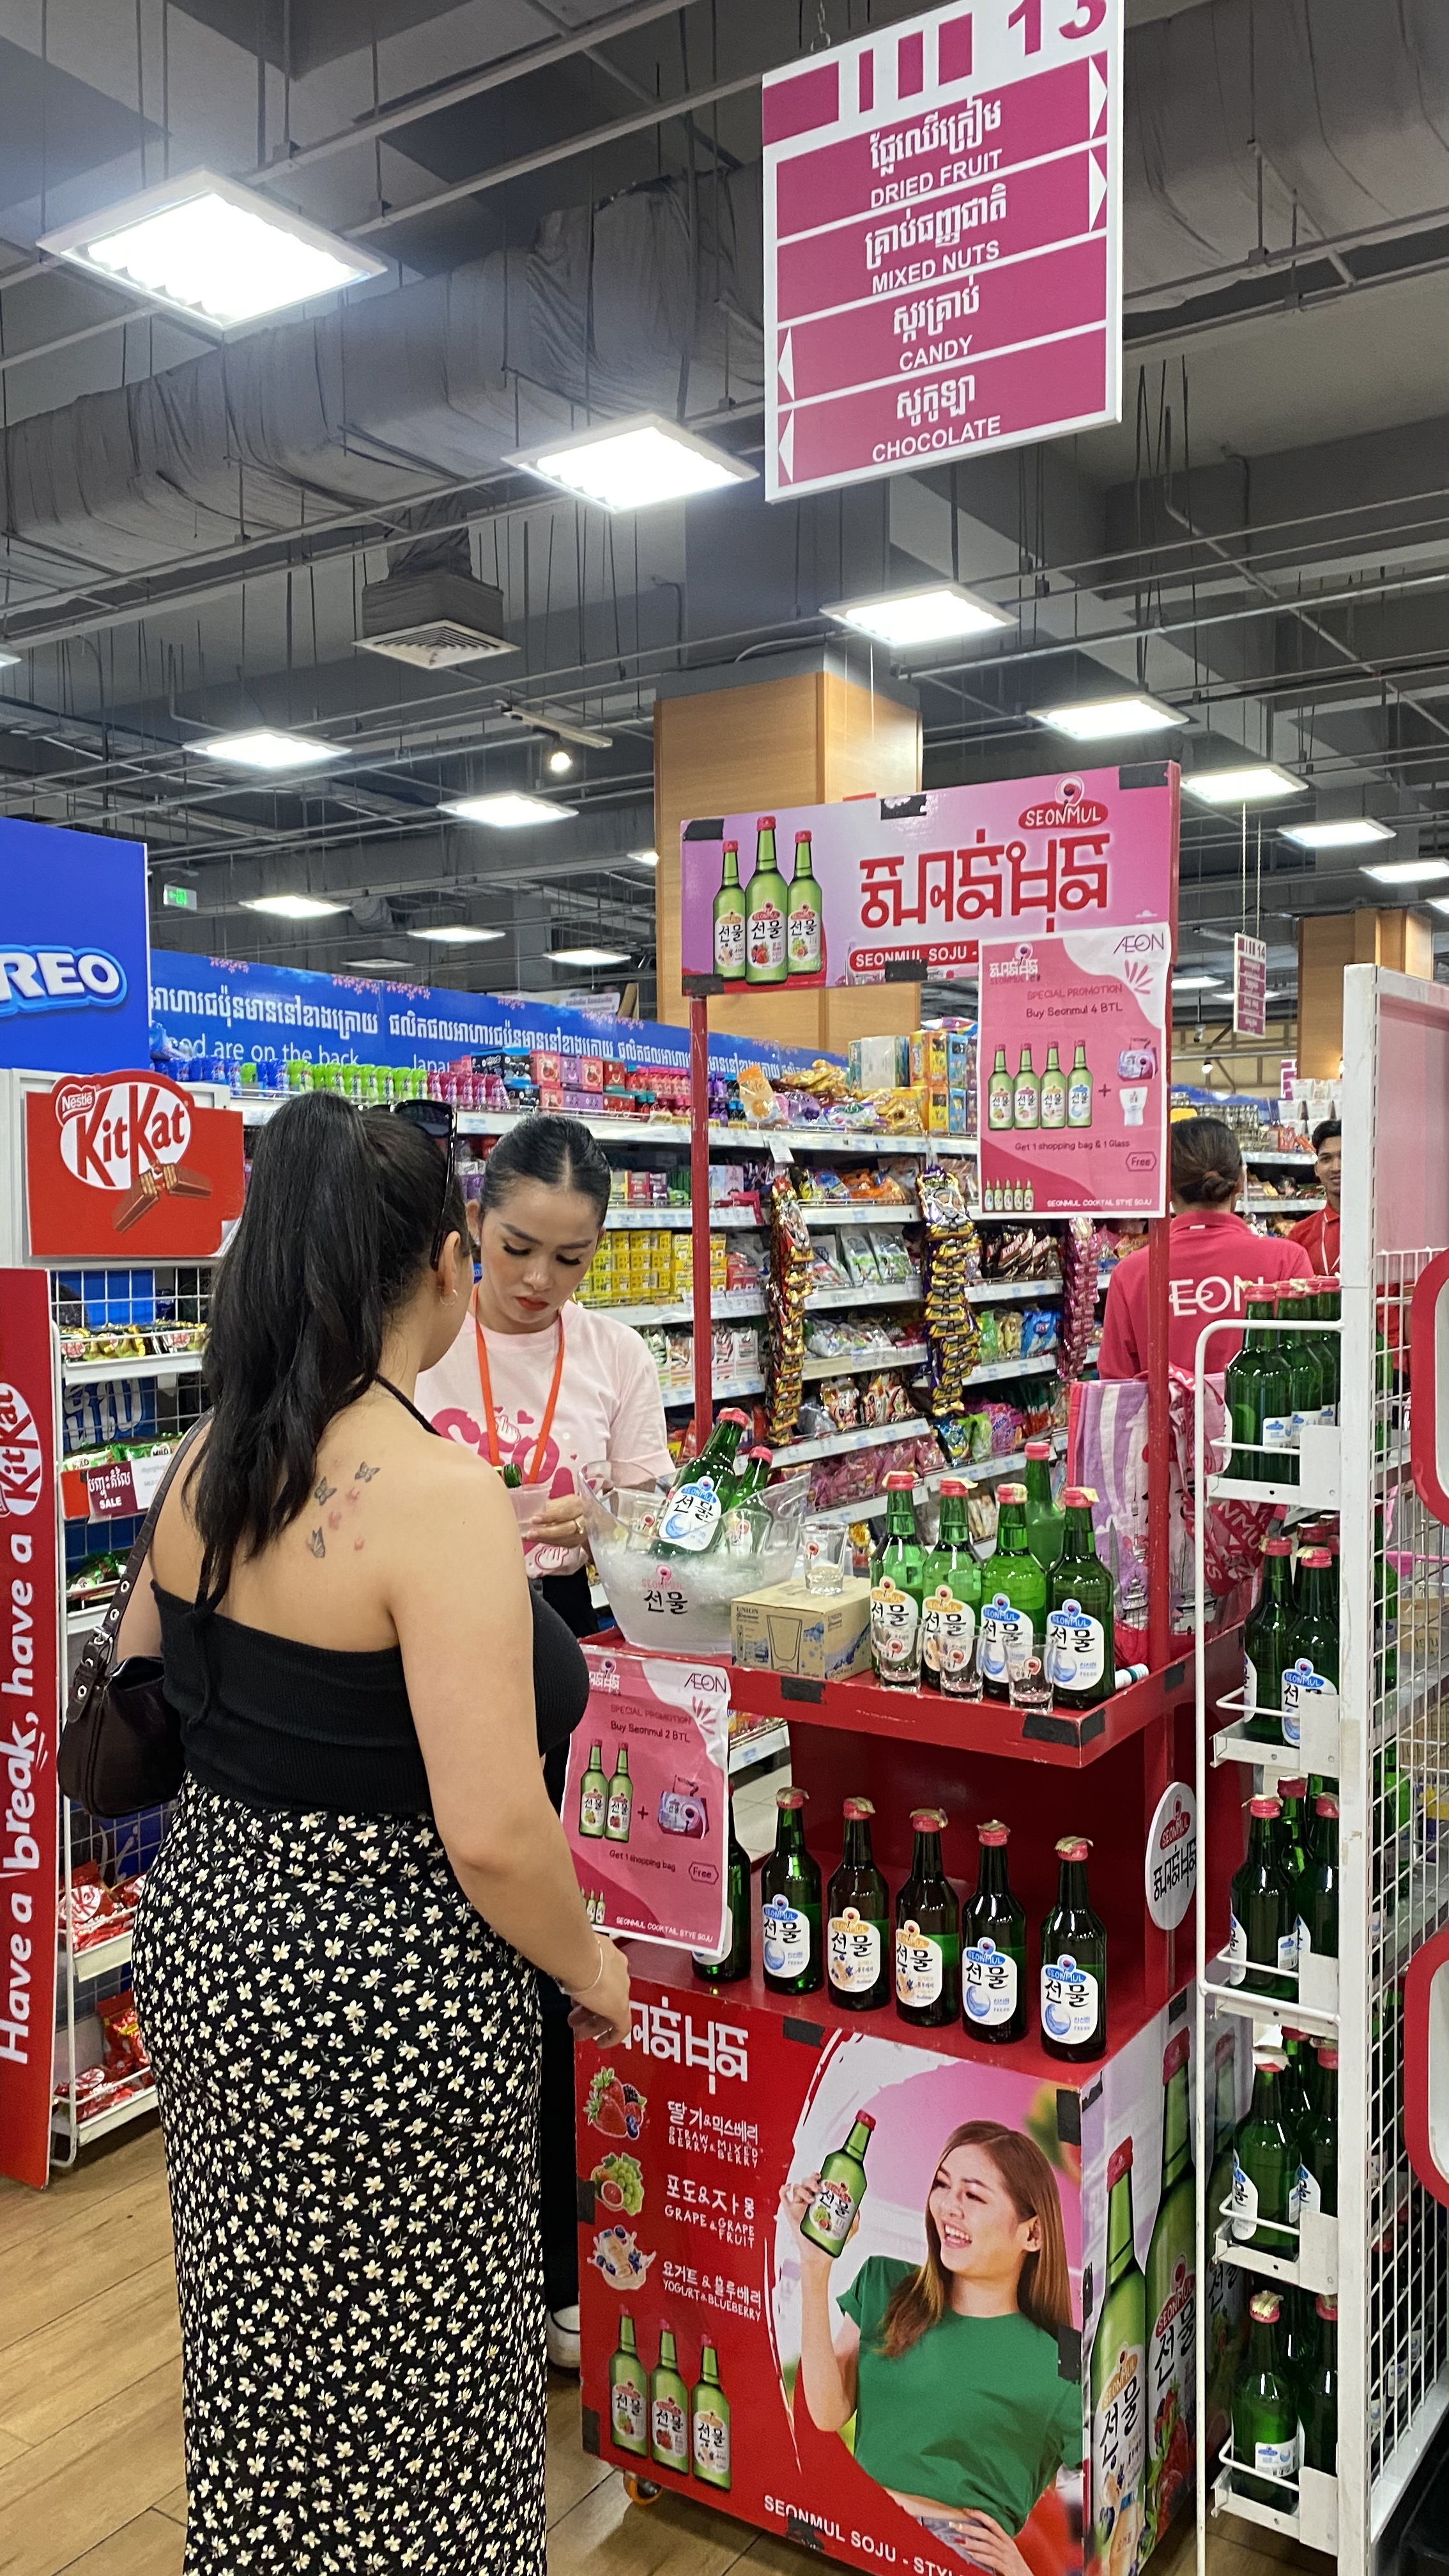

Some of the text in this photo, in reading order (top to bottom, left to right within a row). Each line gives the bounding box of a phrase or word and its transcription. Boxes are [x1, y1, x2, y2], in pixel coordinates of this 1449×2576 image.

[871, 148, 1002, 209] DRIED FRUIT
[873, 240, 1000, 294] MIXED NUTS
[900, 334, 973, 371] CANDY
[897, 374, 975, 427] សូកូឡា
[872, 415, 1001, 463] CHOCOLATE
[1025, 805, 1101, 827] SEONMUL
[719, 924, 743, 943] 선물
[751, 920, 782, 940] 선물
[790, 919, 817, 936] 선물
[929, 946, 967, 962] SOJU
[1027, 985, 1123, 1000] SPECIAL PROMOTION
[1026, 1002, 1123, 1020] Buy Seonmul 4 BTL
[213, 1041, 244, 1061] are
[250, 1045, 276, 1062] on
[282, 1042, 312, 1061] the
[77, 1084, 185, 1187] KitKat
[1015, 1142, 1031, 1151] Get
[1039, 1142, 1075, 1151] shopping
[1078, 1140, 1092, 1150] bag
[1095, 1140, 1101, 1148] &
[1109, 1139, 1130, 1148] Glass
[1131, 1157, 1151, 1167] Free
[1047, 1199, 1081, 1208] SEONMUL
[100, 1496, 122, 1510] SALE
[673, 1495, 714, 1523] 선물
[11, 1533, 32, 1564] a
[643, 1590, 689, 1615] 선물
[737, 1606, 759, 1614] UNION
[871, 1601, 909, 1627] 선물
[926, 1611, 967, 1637] 선물
[983, 1619, 1023, 1645] 선물
[2, 1580, 34, 1697] have
[1050, 1625, 1095, 1653] 선물
[610, 1704, 693, 1724] SPECIAL PROMOTION
[611, 1720, 691, 1743] Buy Seonmul 2 BTL
[610, 1850, 624, 1859] Get
[630, 1854, 661, 1869] shopping
[663, 1860, 676, 1873] bag
[693, 1866, 712, 1879] Free
[11, 1894, 32, 1920] a
[763, 1918, 801, 1943] 선물
[832, 1932, 873, 1958] 선물
[896, 1944, 933, 1973] 선물
[966, 1961, 1009, 1989] 선물
[1, 1928, 31, 2064] Have
[1045, 1978, 1090, 2007] 선물
[669, 2126, 758, 2158] STRAW MIXED
[664, 2204, 755, 2237] GRAPE & GRAPE
[719, 2229, 755, 2248] FRUIT
[663, 2260, 762, 2310] 요거트 & 블루베리
[1100, 2375, 1140, 2469] 선물
[851, 2531, 896, 2563] SOJU
